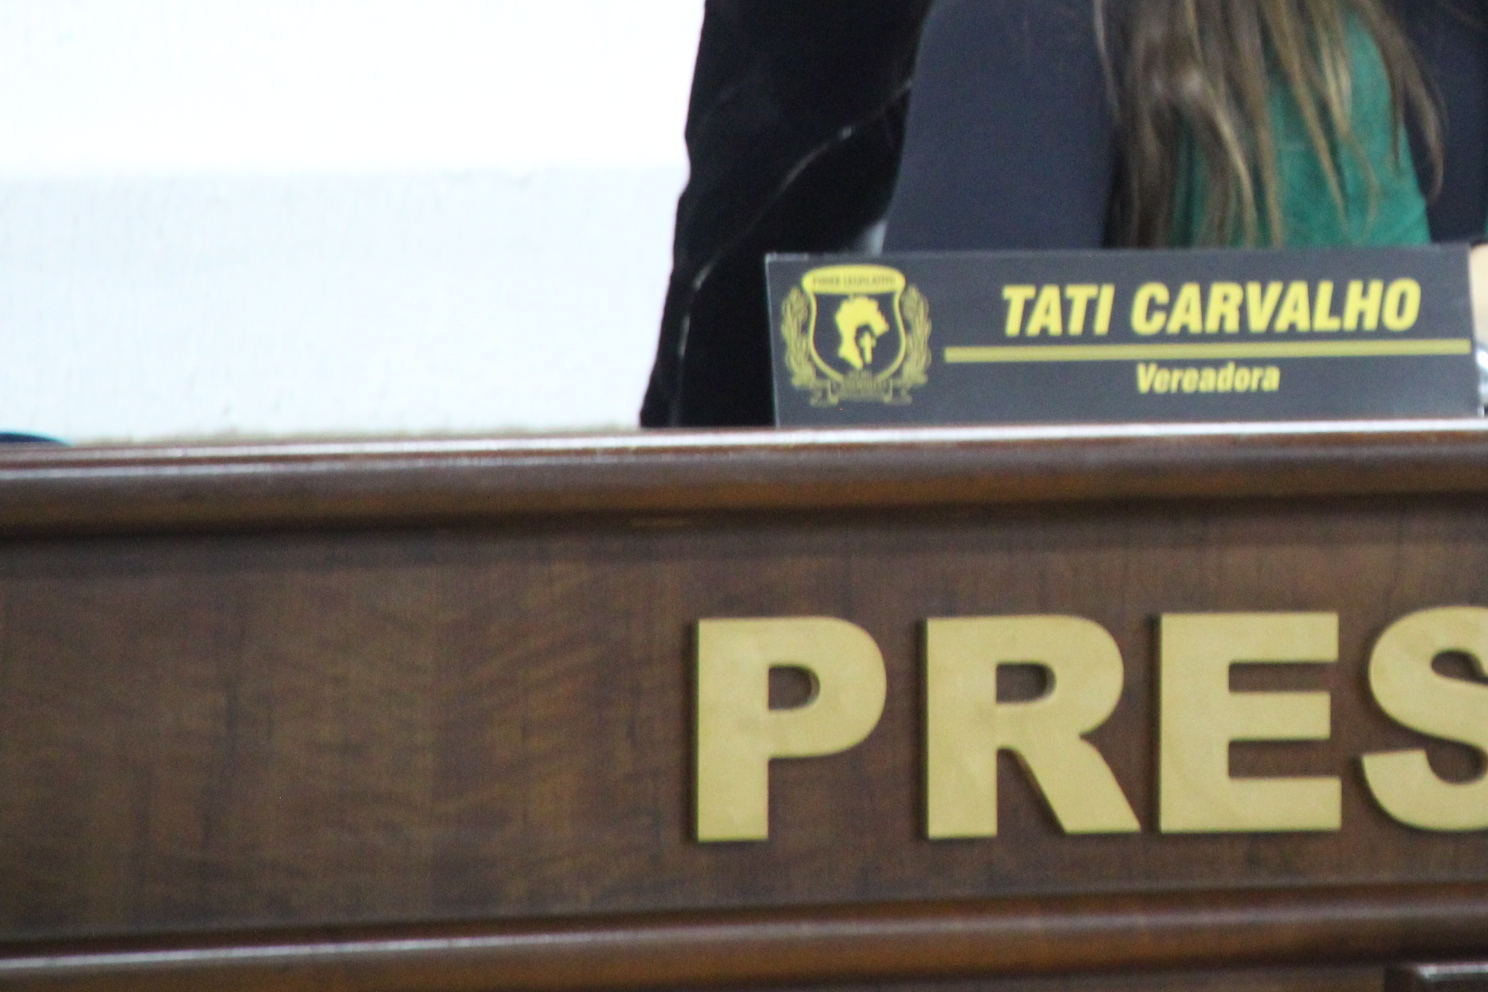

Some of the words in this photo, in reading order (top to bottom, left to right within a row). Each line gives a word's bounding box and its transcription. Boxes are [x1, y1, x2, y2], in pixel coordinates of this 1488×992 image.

[1001, 283, 1114, 336] TATI
[1131, 278, 1421, 334] CARVALHO
[1137, 362, 1279, 394] Vereadora
